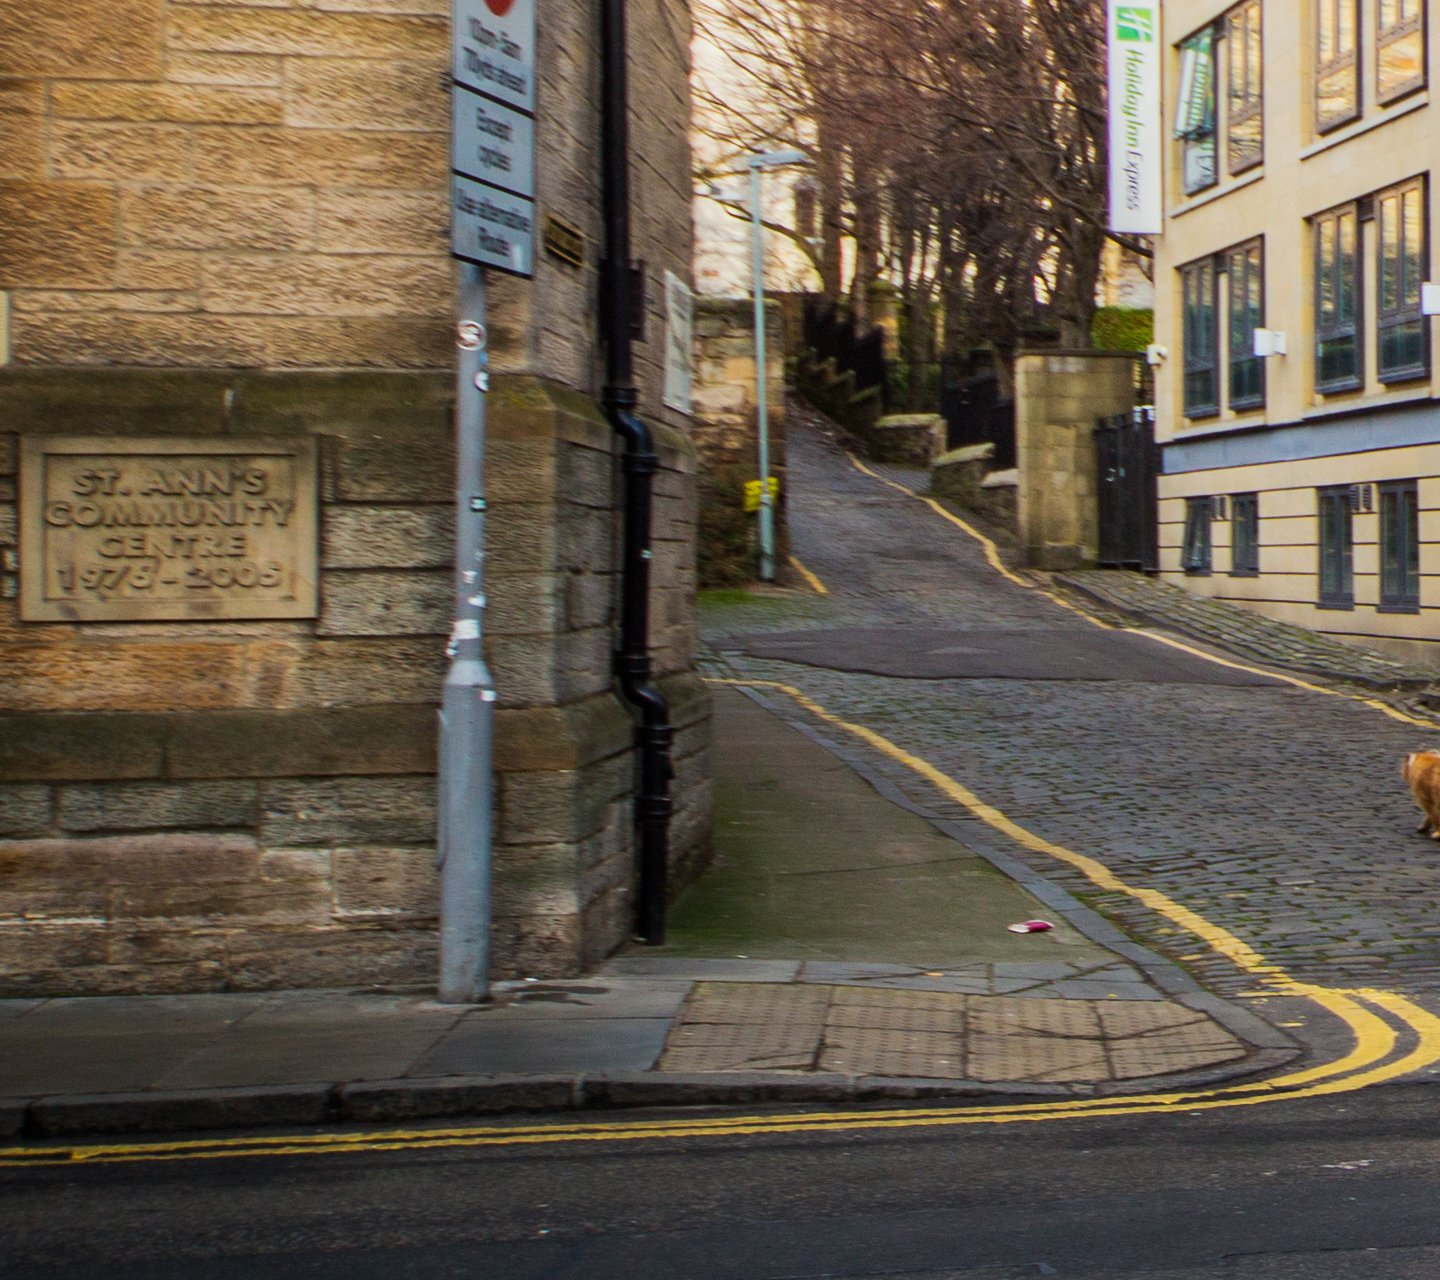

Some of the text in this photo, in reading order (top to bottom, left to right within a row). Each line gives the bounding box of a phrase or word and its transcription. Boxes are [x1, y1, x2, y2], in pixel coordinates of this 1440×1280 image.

[1121, 48, 1145, 211] Holiday Inn Express
[72, 467, 269, 497] ST. ANN'S
[45, 499, 292, 528] COMMUNITY
[97, 534, 248, 560] CENTRE
